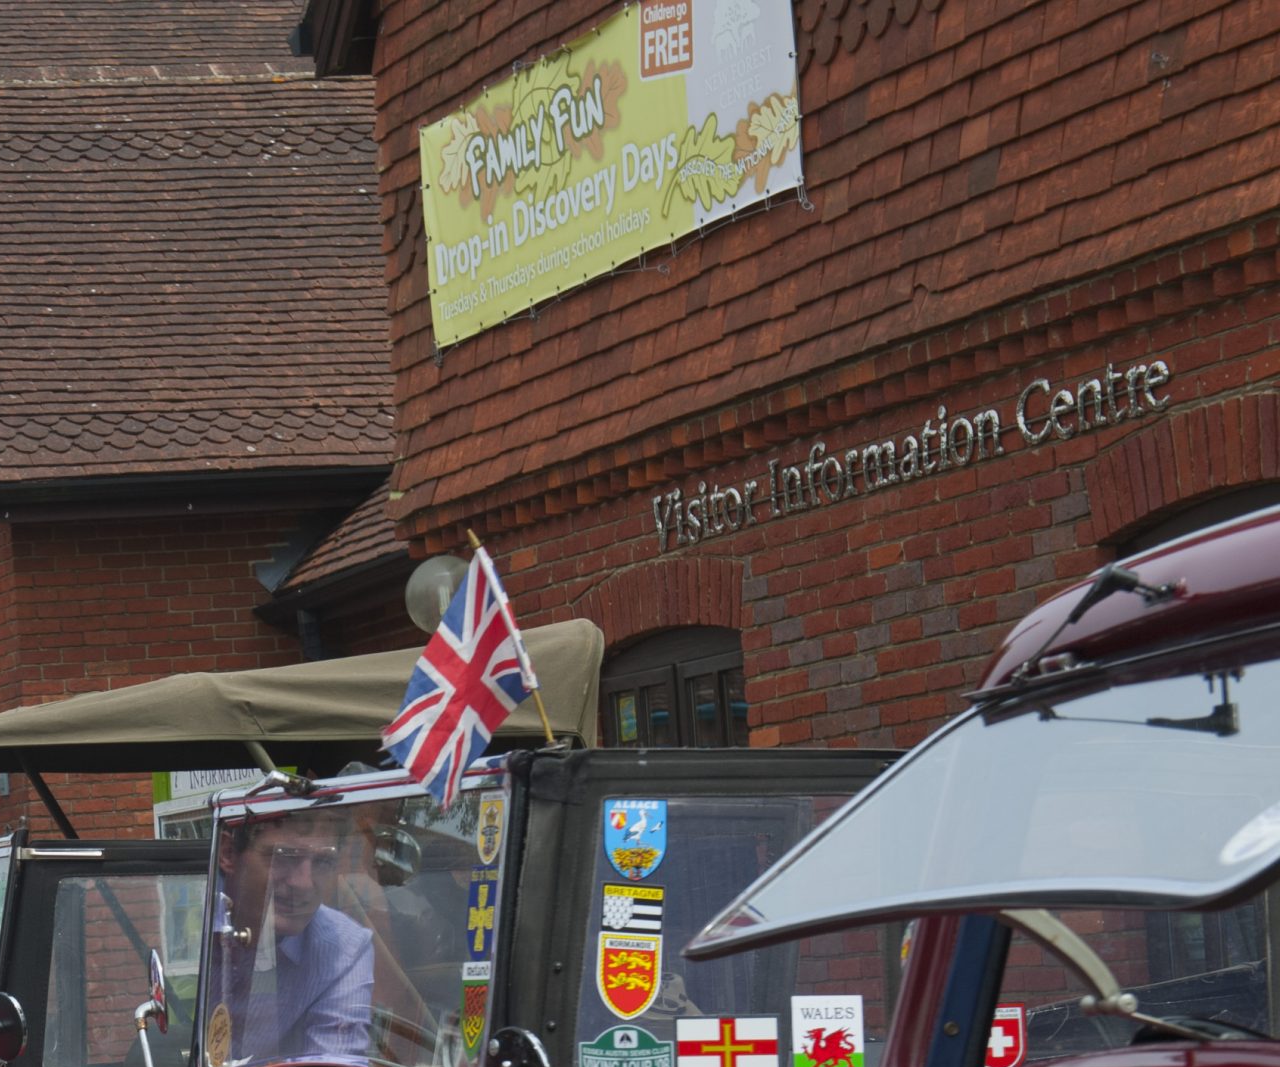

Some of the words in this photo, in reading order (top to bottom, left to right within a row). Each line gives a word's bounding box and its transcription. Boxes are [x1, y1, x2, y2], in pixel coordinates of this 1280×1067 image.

[643, 4, 676, 24] Children
[676, 3, 687, 21] go
[644, 23, 690, 69] FREE
[465, 103, 544, 200] FAMILY
[435, 215, 509, 286] Drop-in
[512, 164, 617, 246] Discovery
[622, 132, 679, 192] Days
[438, 290, 479, 321] Tuesdays
[487, 267, 536, 298] Thursdays
[537, 249, 570, 274] during
[571, 232, 605, 258] school
[606, 208, 651, 241] holidays
[652, 479, 758, 553] Visitor
[768, 404, 1005, 518] Information
[1016, 358, 1172, 445] Centre
[189, 768, 255, 789] INFORMATION
[613, 800, 659, 810] ALSACE
[605, 886, 662, 899] BRETAGNE
[608, 939, 653, 950] NORMANDIE
[801, 1006, 855, 1020] WALES
